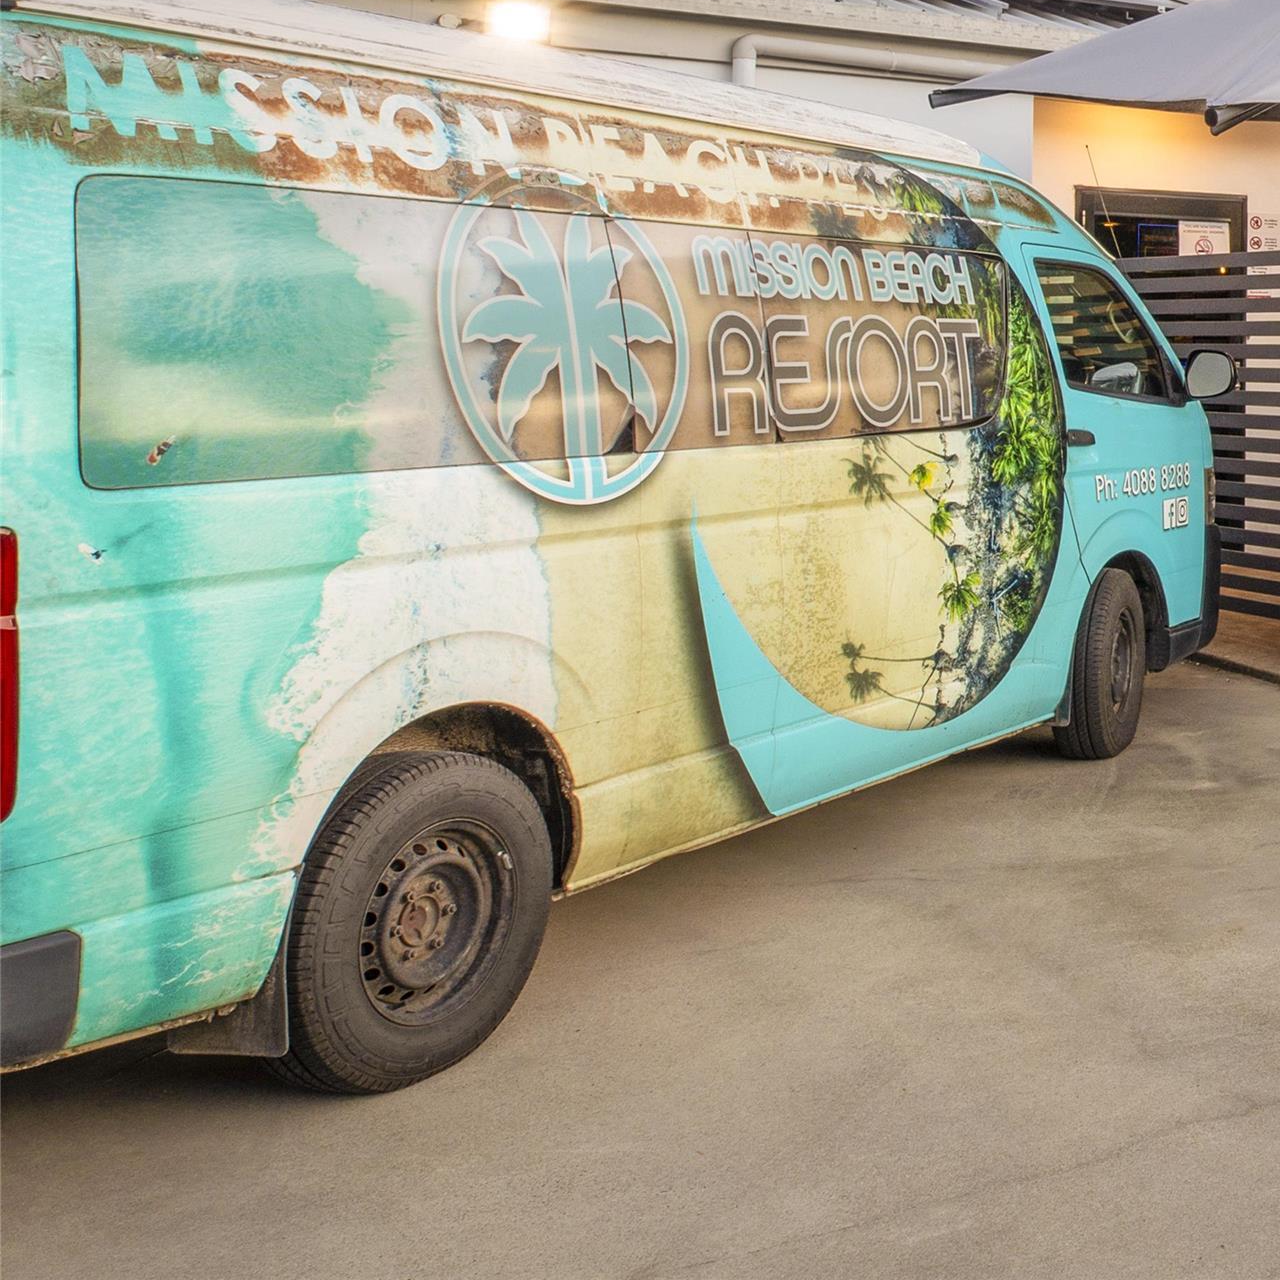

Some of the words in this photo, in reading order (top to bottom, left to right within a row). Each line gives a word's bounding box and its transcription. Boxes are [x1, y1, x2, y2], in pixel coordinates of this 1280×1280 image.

[61, 44, 522, 179] MISSION
[691, 234, 864, 302] MISSION
[861, 248, 976, 305] BEACH
[708, 310, 980, 437] RESORT
[1095, 474, 1118, 502] Ph:
[1122, 467, 1157, 497] 4088
[1160, 462, 1191, 492] 8288
